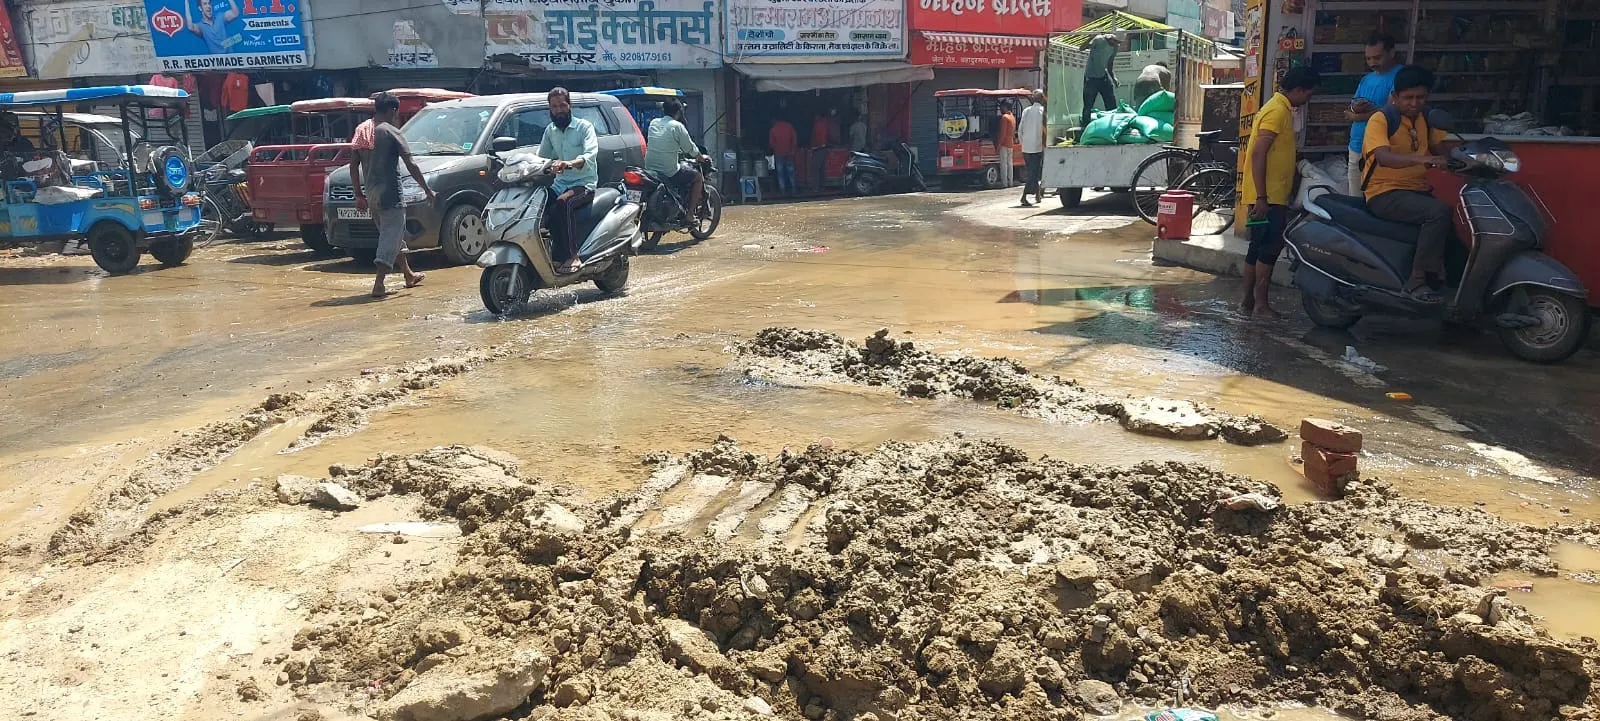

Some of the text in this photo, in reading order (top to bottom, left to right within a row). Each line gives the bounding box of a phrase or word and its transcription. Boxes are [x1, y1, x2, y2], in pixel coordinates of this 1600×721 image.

[156, 15, 180, 28] T.T.
[248, 19, 290, 28] Garments
[274, 35, 299, 44] COOL
[163, 54, 302, 69] R.R. READYMADE GARMENTS
